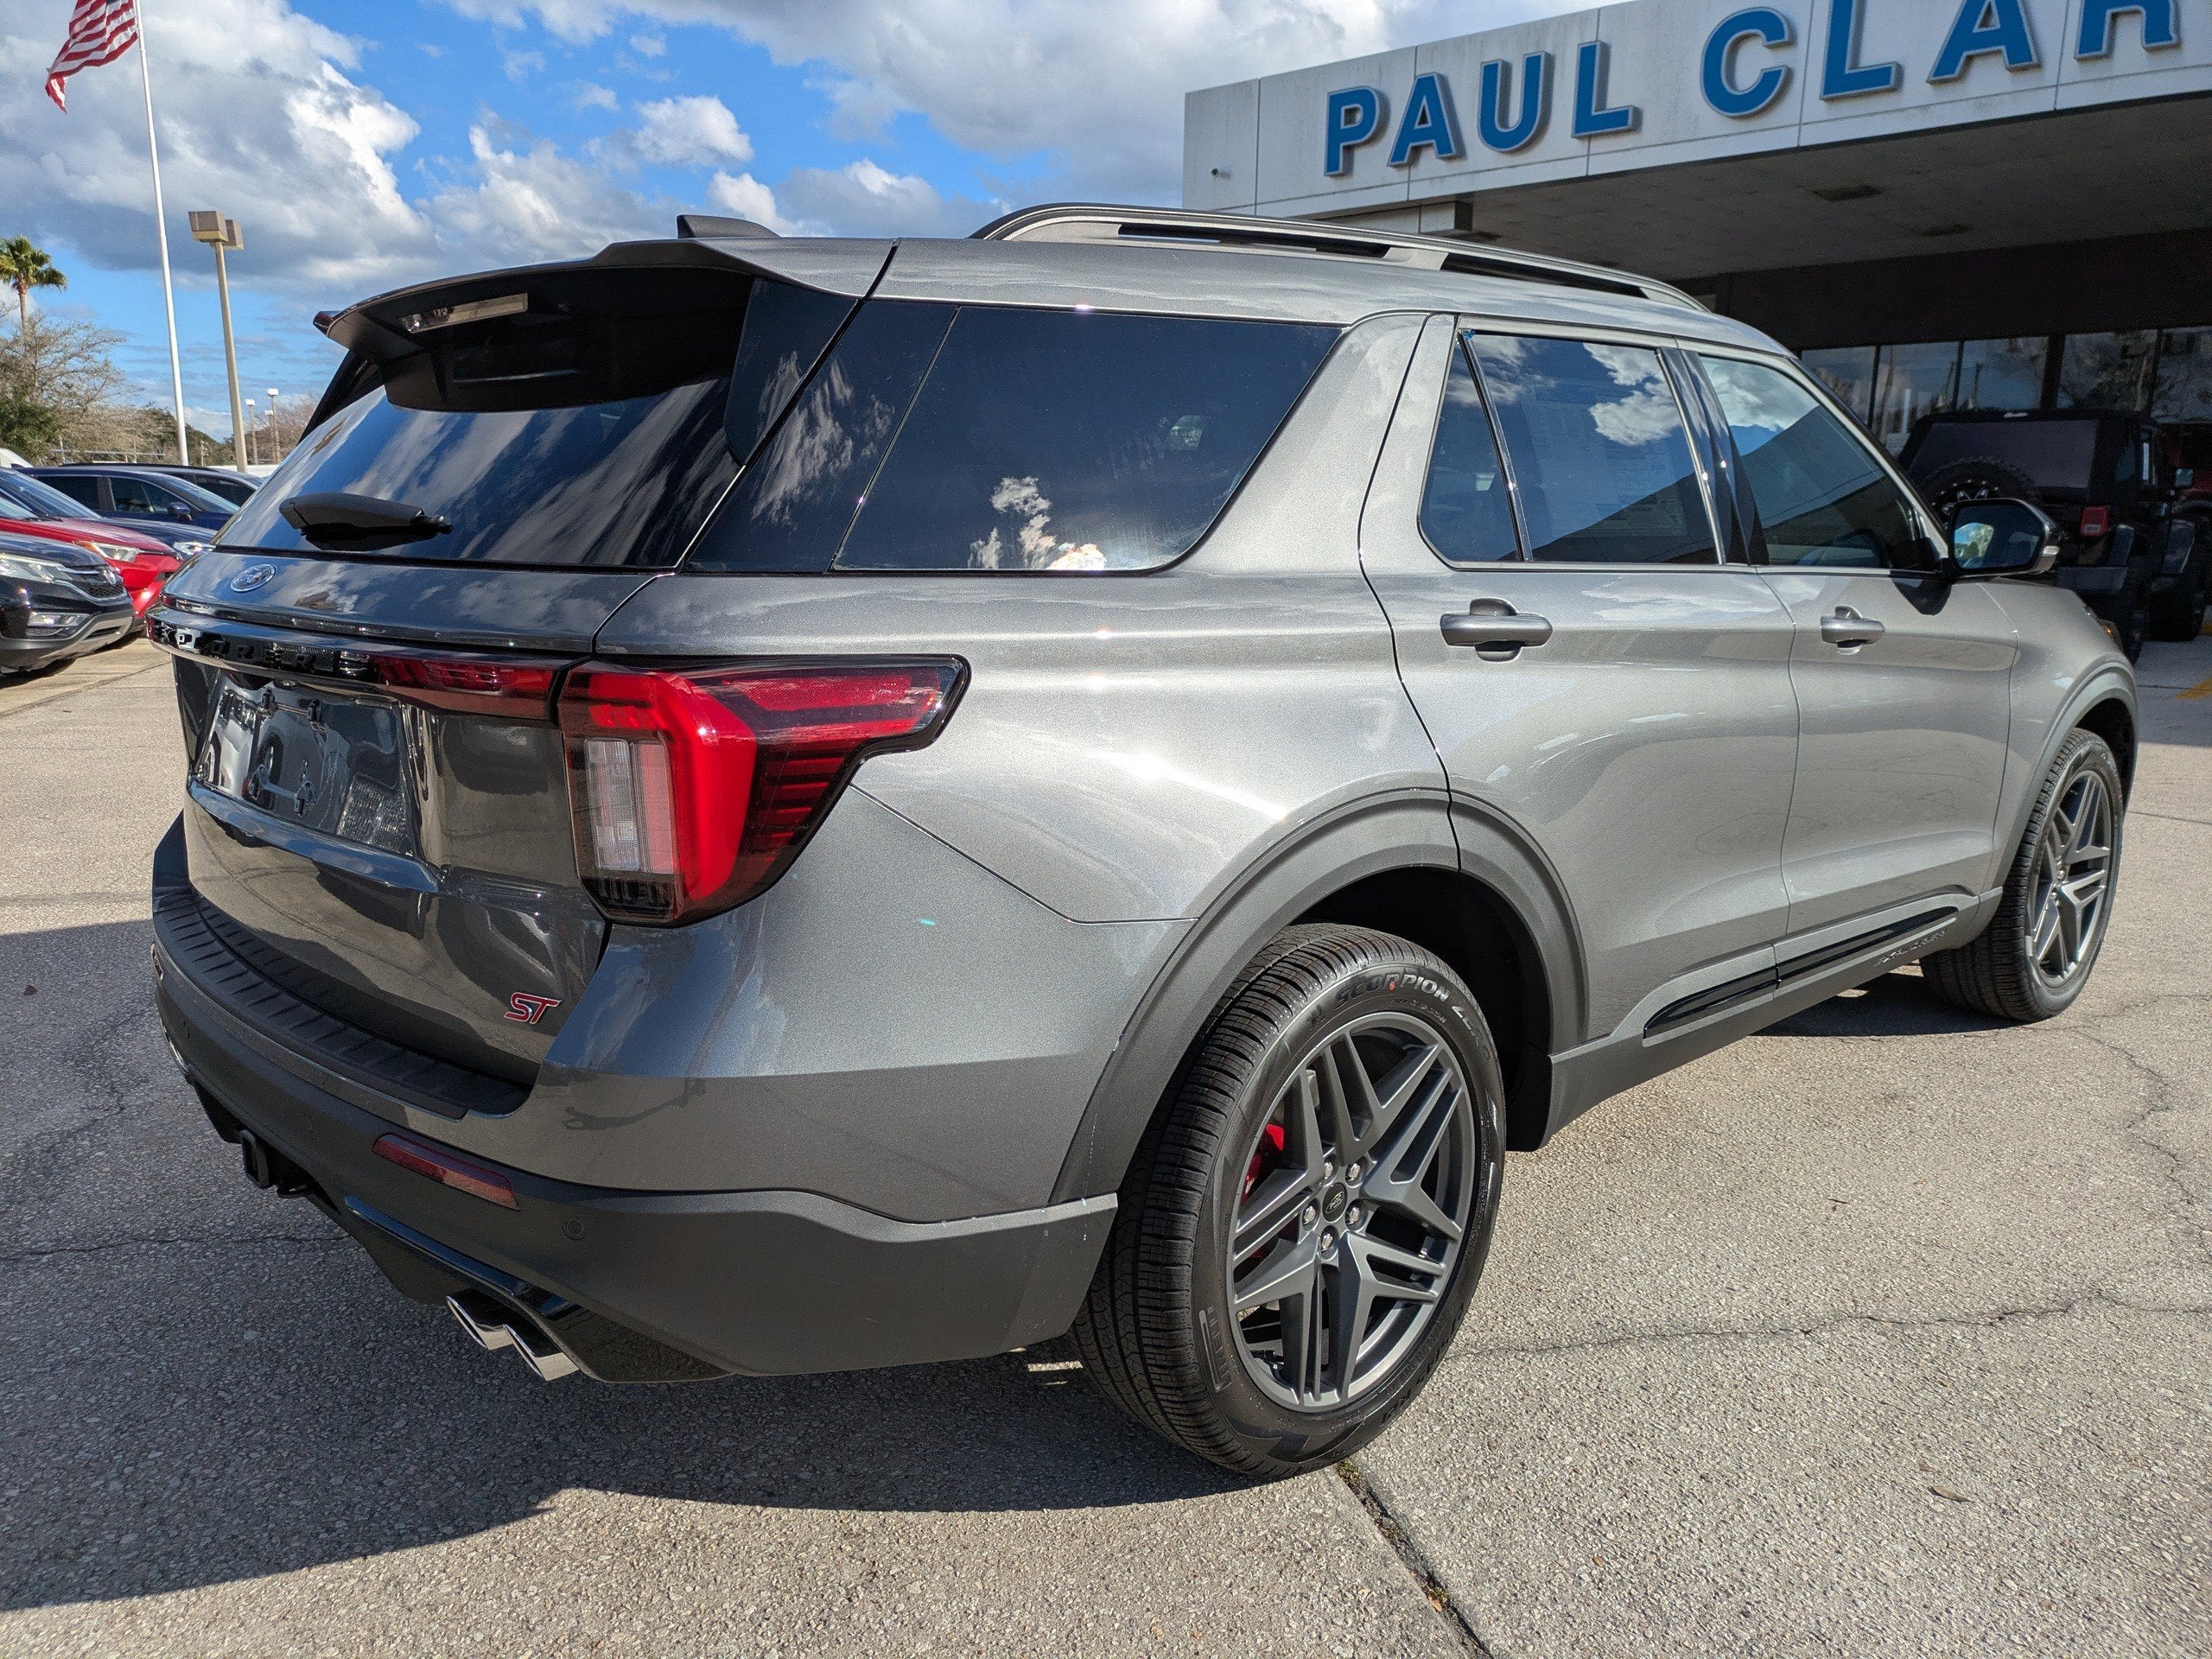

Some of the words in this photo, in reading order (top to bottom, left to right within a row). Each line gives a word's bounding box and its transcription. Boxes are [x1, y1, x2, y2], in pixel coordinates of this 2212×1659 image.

[1324, 40, 1642, 177] PAUL
[504, 992, 563, 1024] ST
[1335, 973, 1452, 1009] SCORPION
